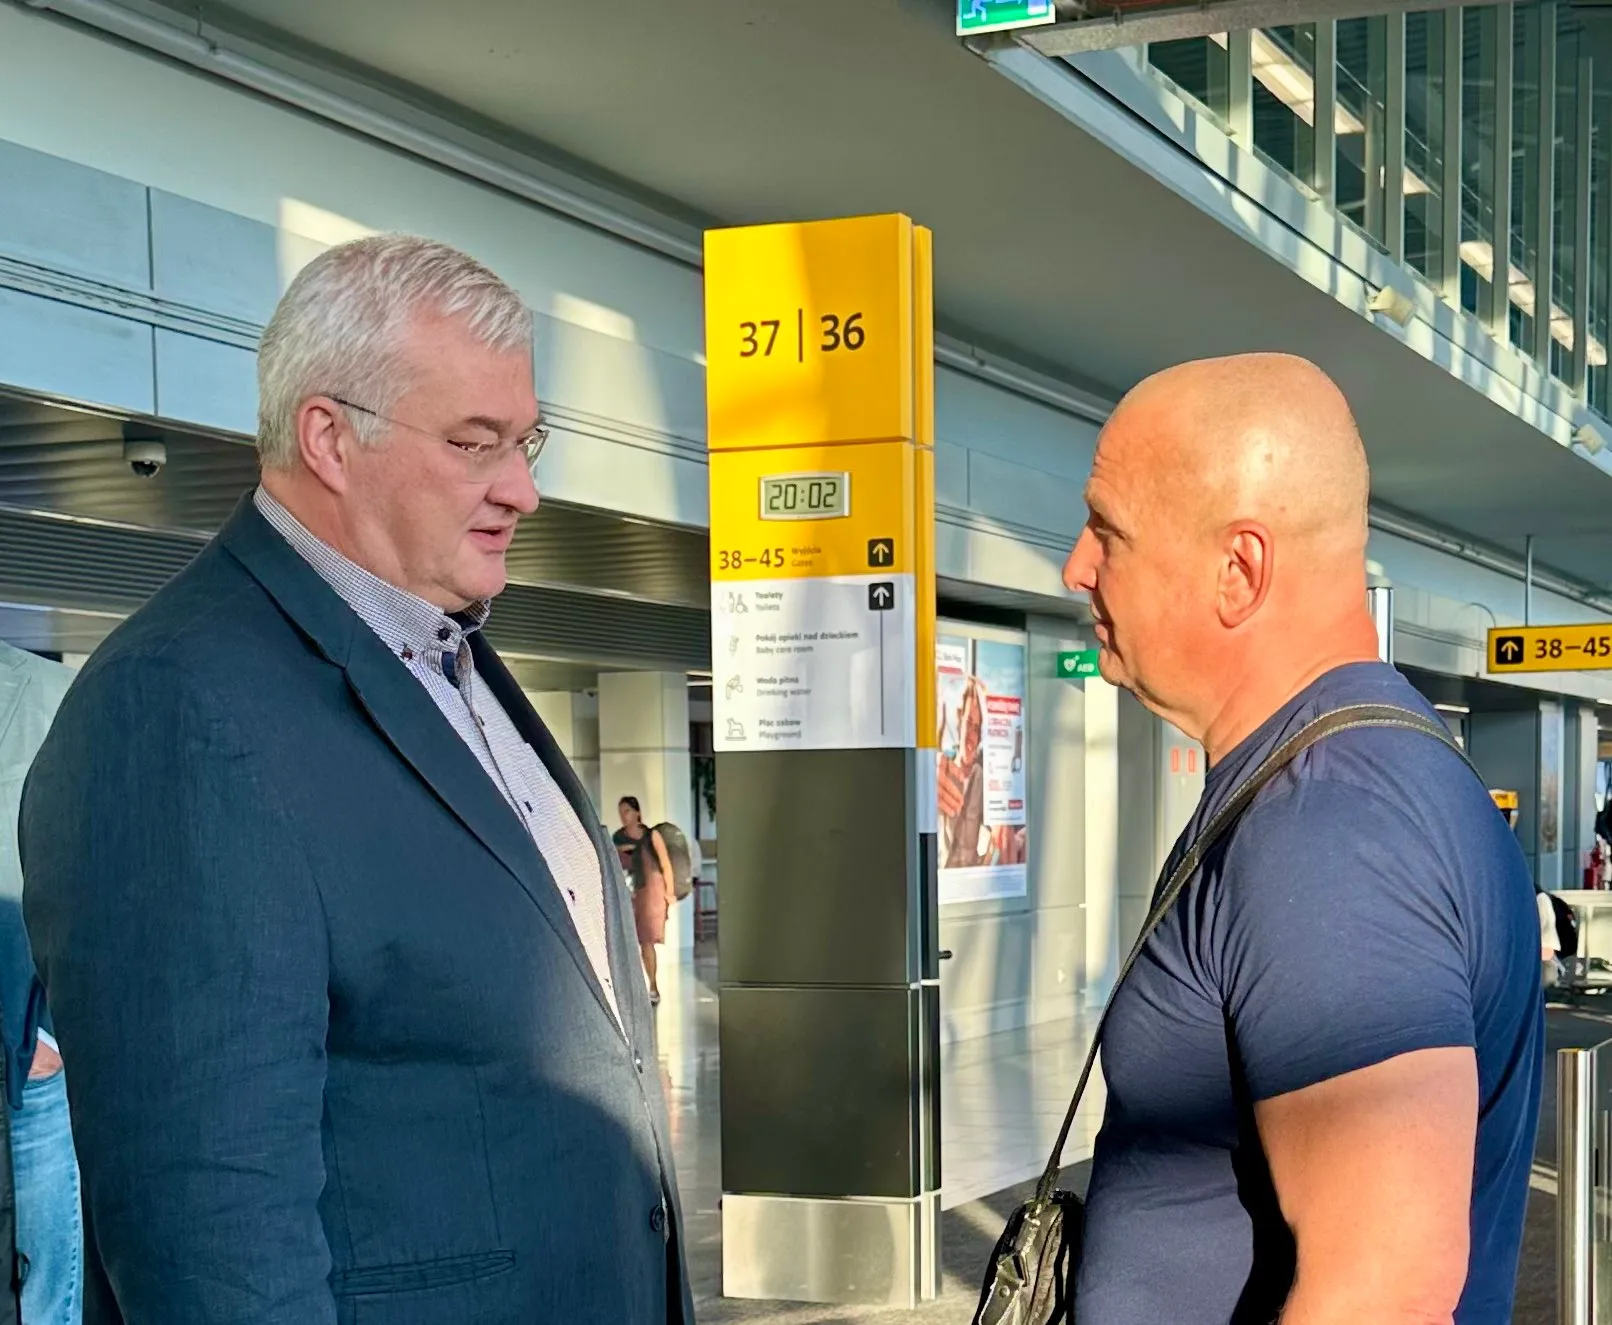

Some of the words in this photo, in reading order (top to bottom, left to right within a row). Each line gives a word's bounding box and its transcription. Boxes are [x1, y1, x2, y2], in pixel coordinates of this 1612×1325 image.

[739, 320, 780, 357] 37
[820, 312, 865, 351] 36
[769, 482, 837, 511] 20:02
[1077, 662, 1095, 673] AED
